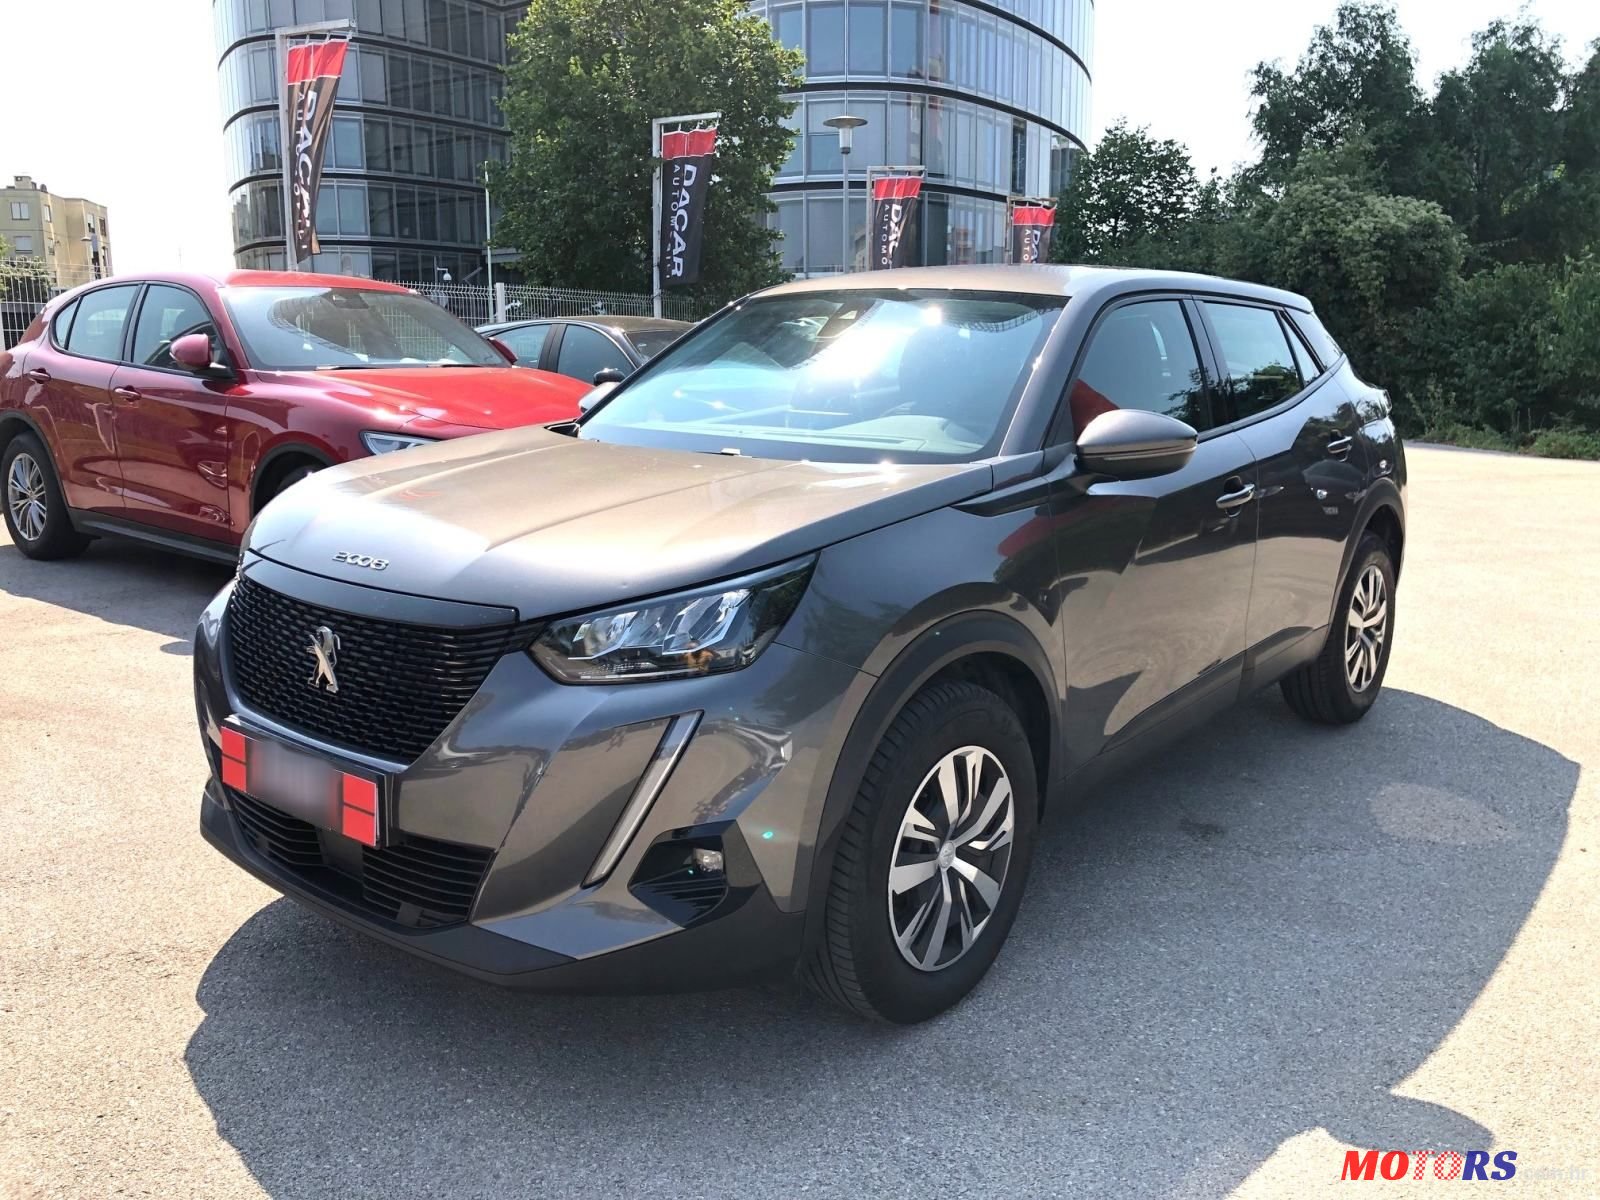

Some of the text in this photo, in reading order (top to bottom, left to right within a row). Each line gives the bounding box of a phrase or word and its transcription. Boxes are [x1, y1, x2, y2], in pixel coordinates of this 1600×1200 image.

[671, 164, 697, 278] DACAR
[888, 203, 903, 268] DAC
[1022, 229, 1031, 261] AUTO
[1031, 230, 1041, 264] DA
[332, 551, 389, 570] 2008
